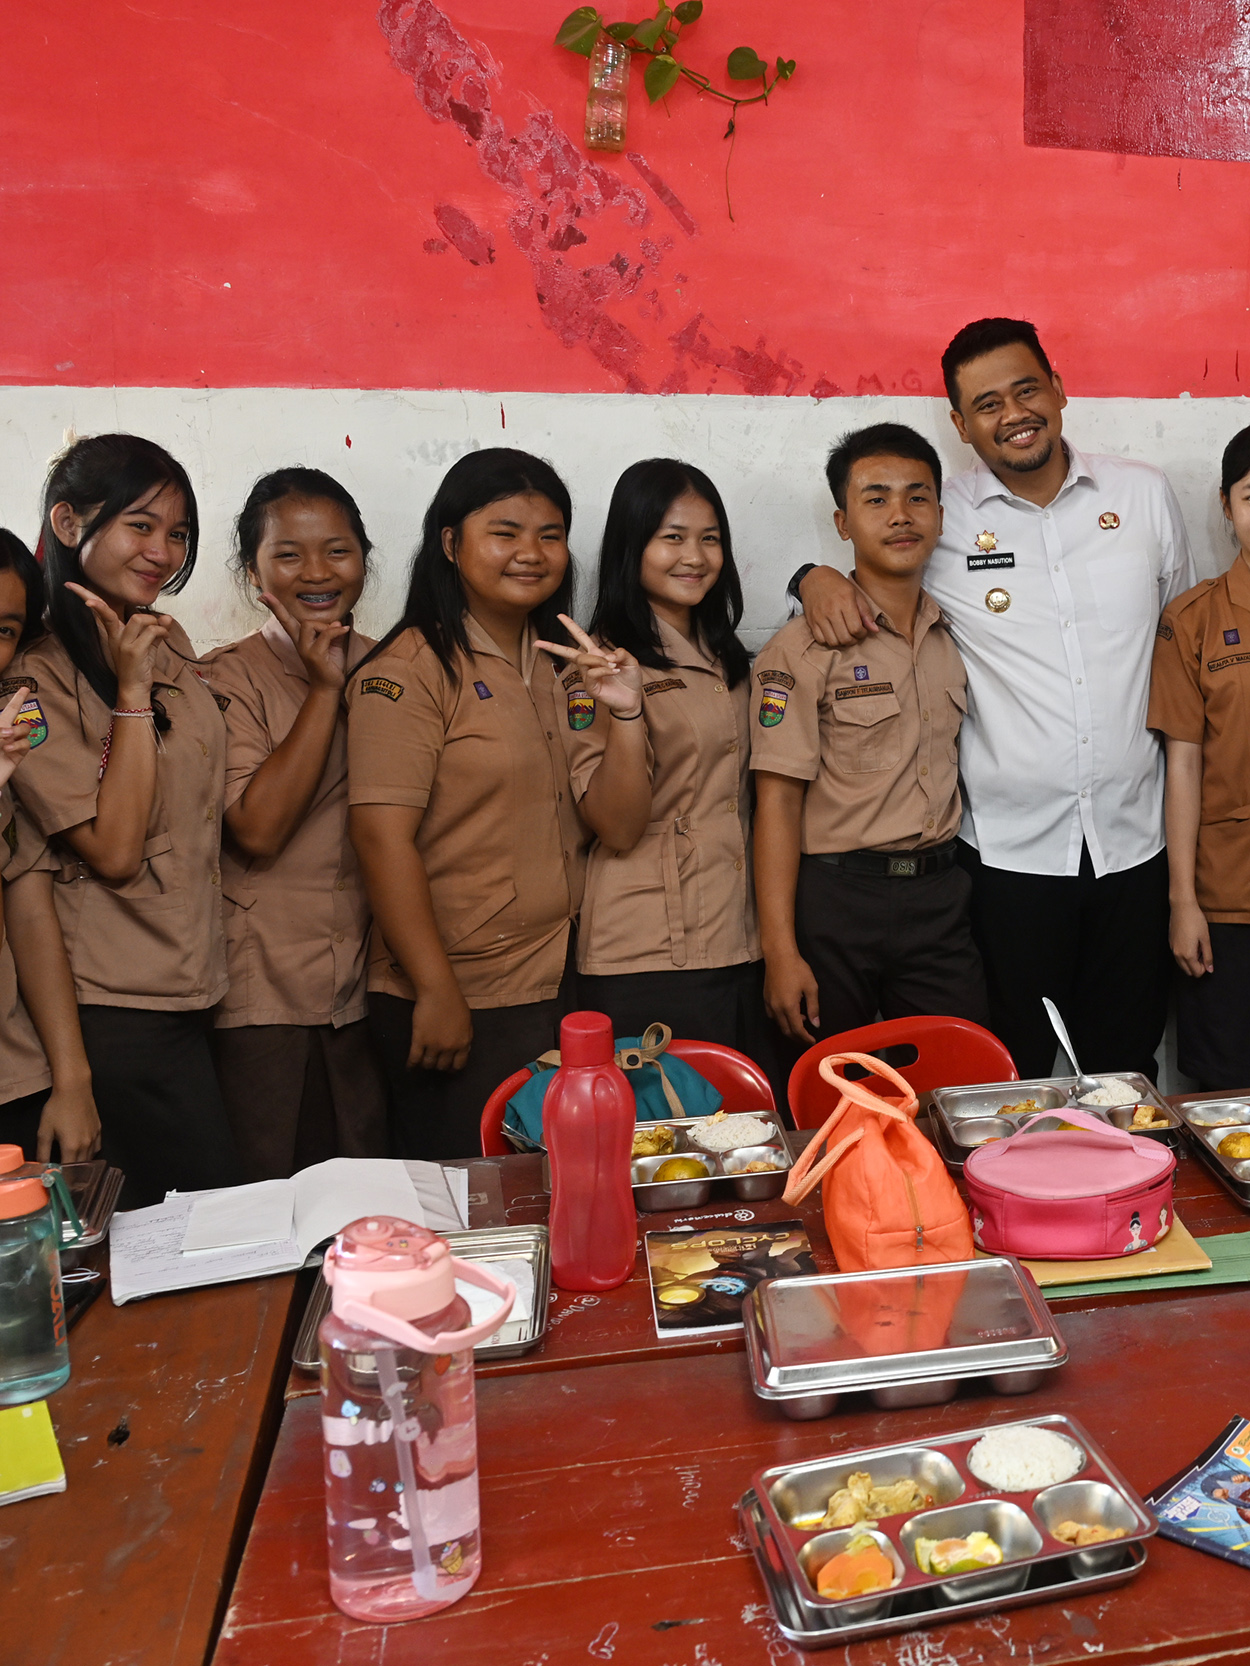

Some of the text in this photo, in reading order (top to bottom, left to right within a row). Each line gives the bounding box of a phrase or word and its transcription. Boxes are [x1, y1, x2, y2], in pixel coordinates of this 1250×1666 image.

[969, 557, 1013, 567] BOBBY NASUTION
[891, 860, 916, 873] OSIS
[671, 1232, 790, 1251] CYCLOPS
